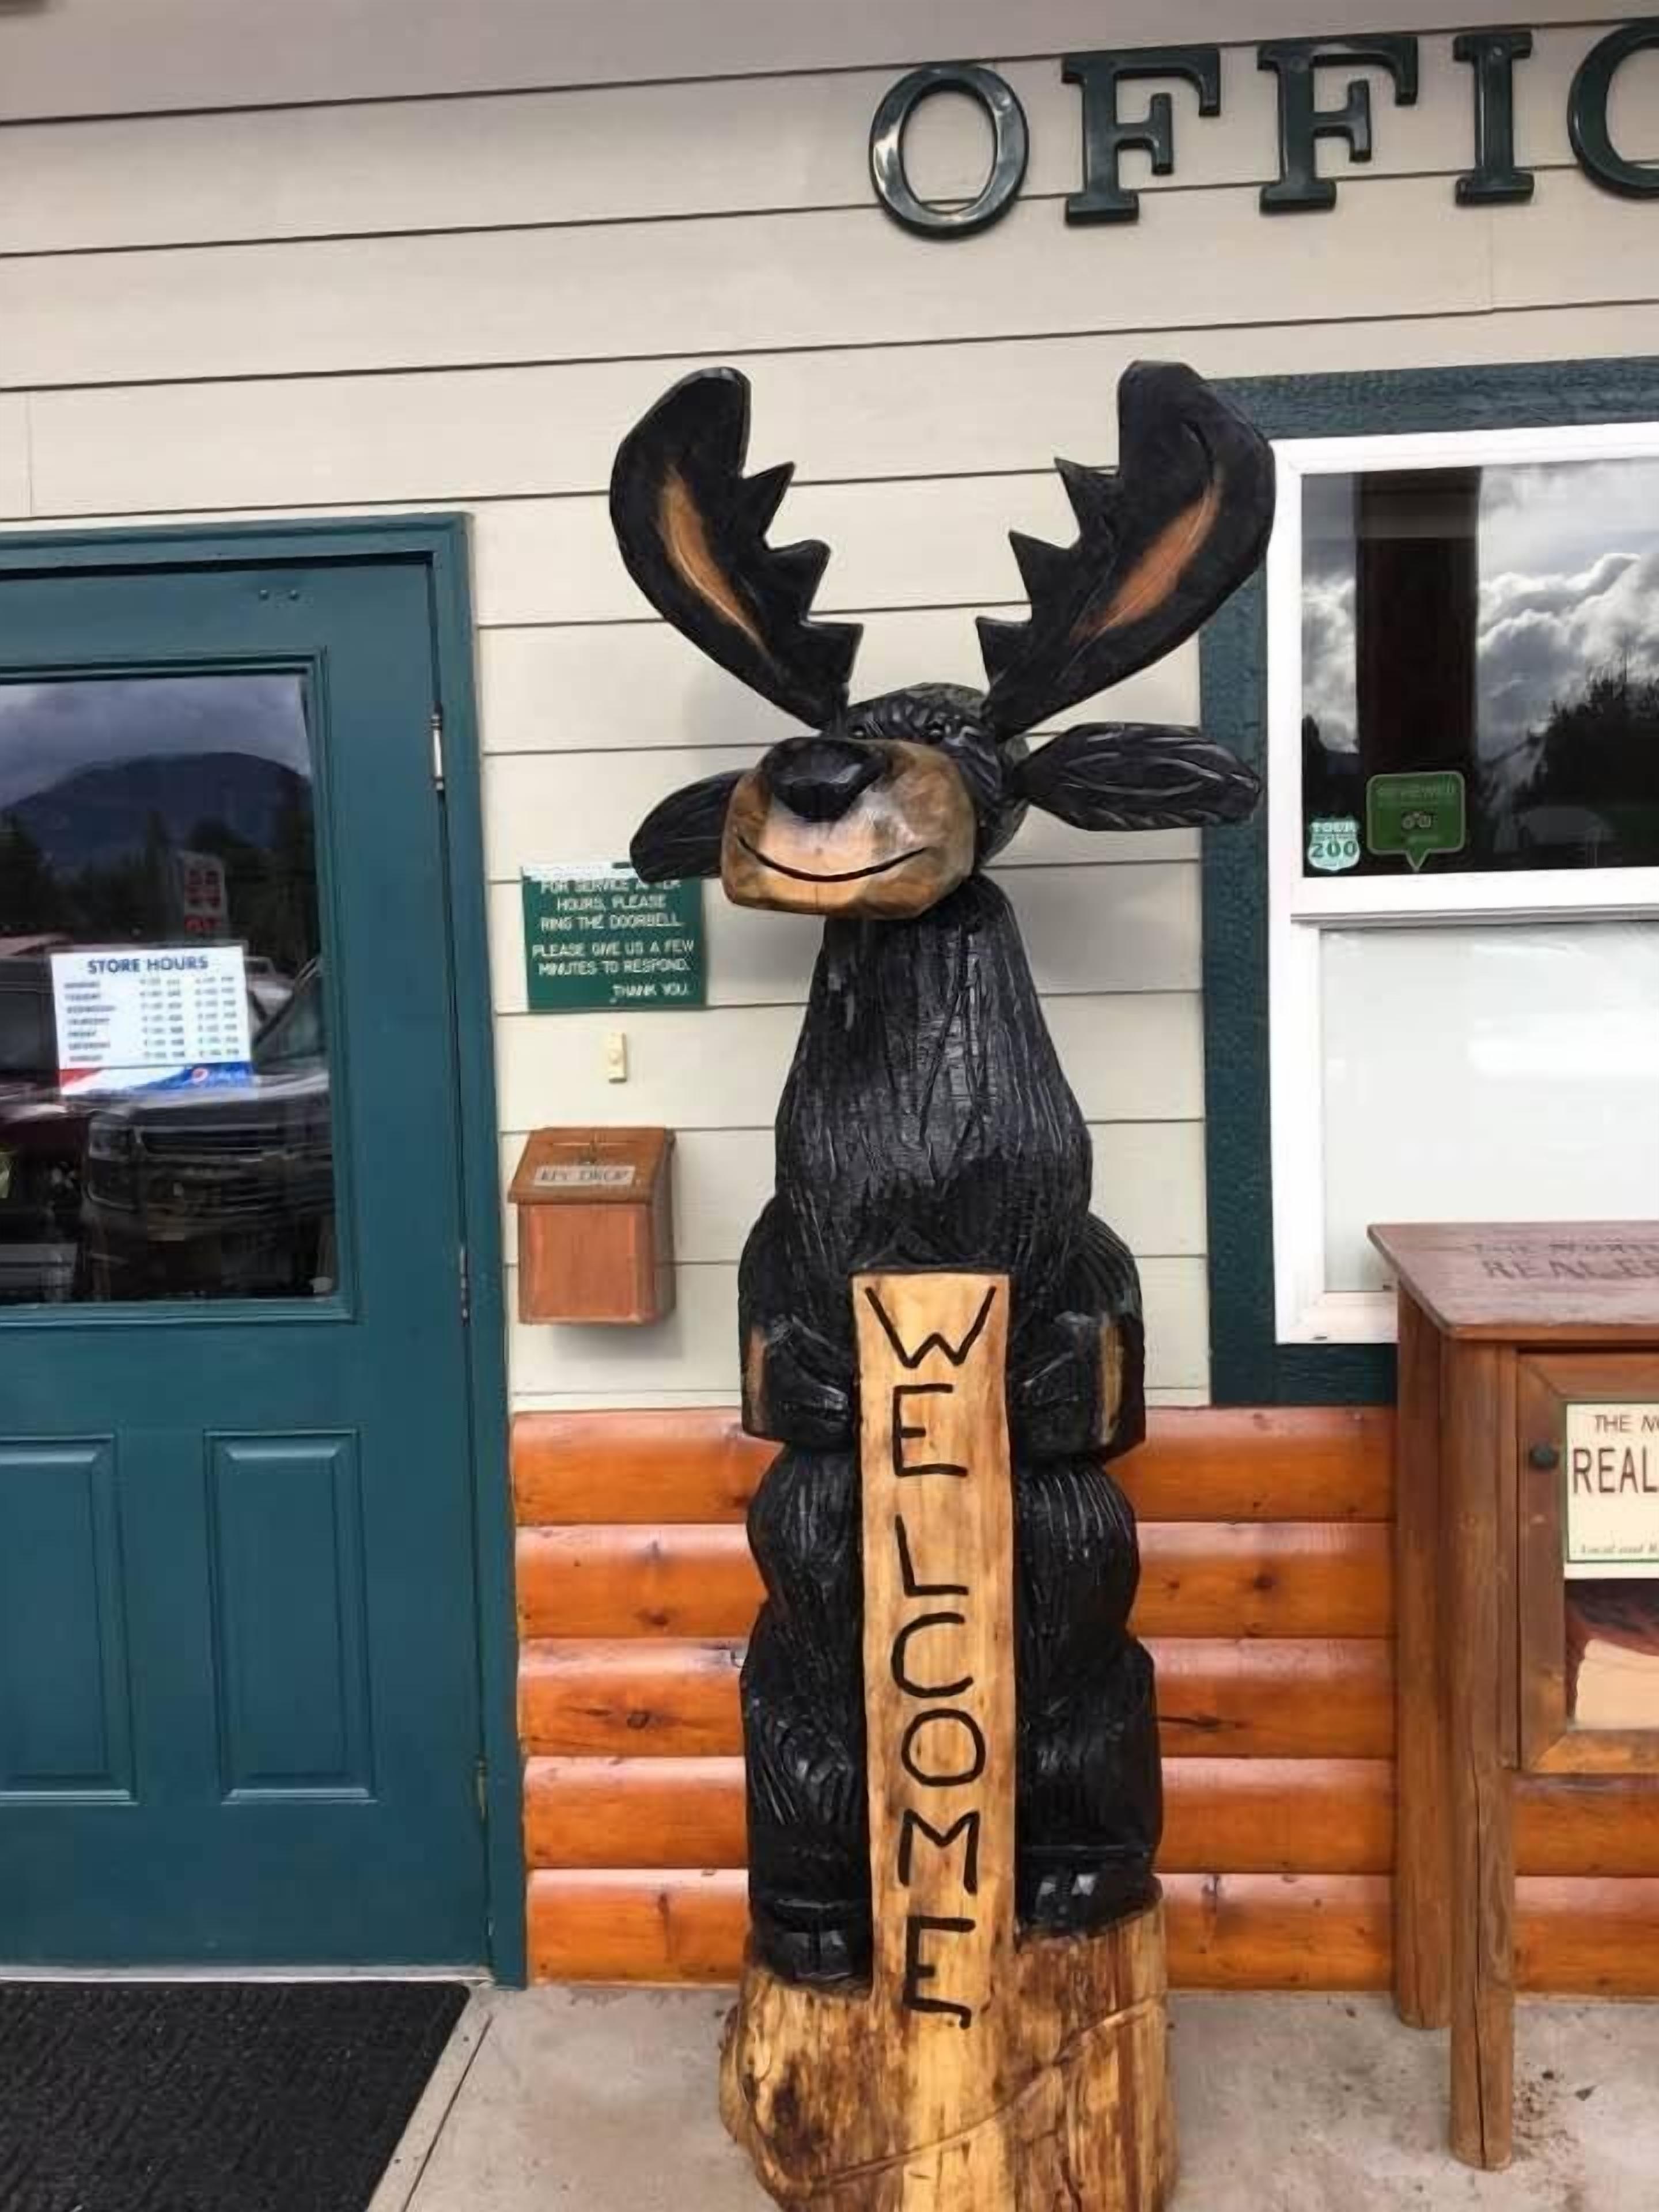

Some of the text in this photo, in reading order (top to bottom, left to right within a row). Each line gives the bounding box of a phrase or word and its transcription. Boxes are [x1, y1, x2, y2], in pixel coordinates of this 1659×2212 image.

[1311, 841, 1358, 858] 200
[611, 893, 666, 908] PLEASE
[540, 916, 571, 931] RING
[578, 915, 604, 929] THE
[532, 939, 694, 958] PLEASE GIVE US A FEW
[88, 956, 209, 975] STORE HOURS
[539, 960, 598, 975] MINUTES
[601, 959, 619, 974] TO
[612, 984, 657, 997] THANK
[1594, 1415, 1633, 1433] THE
[1573, 1447, 1657, 1493] REAL
[865, 1286, 996, 2029] WELCOME
